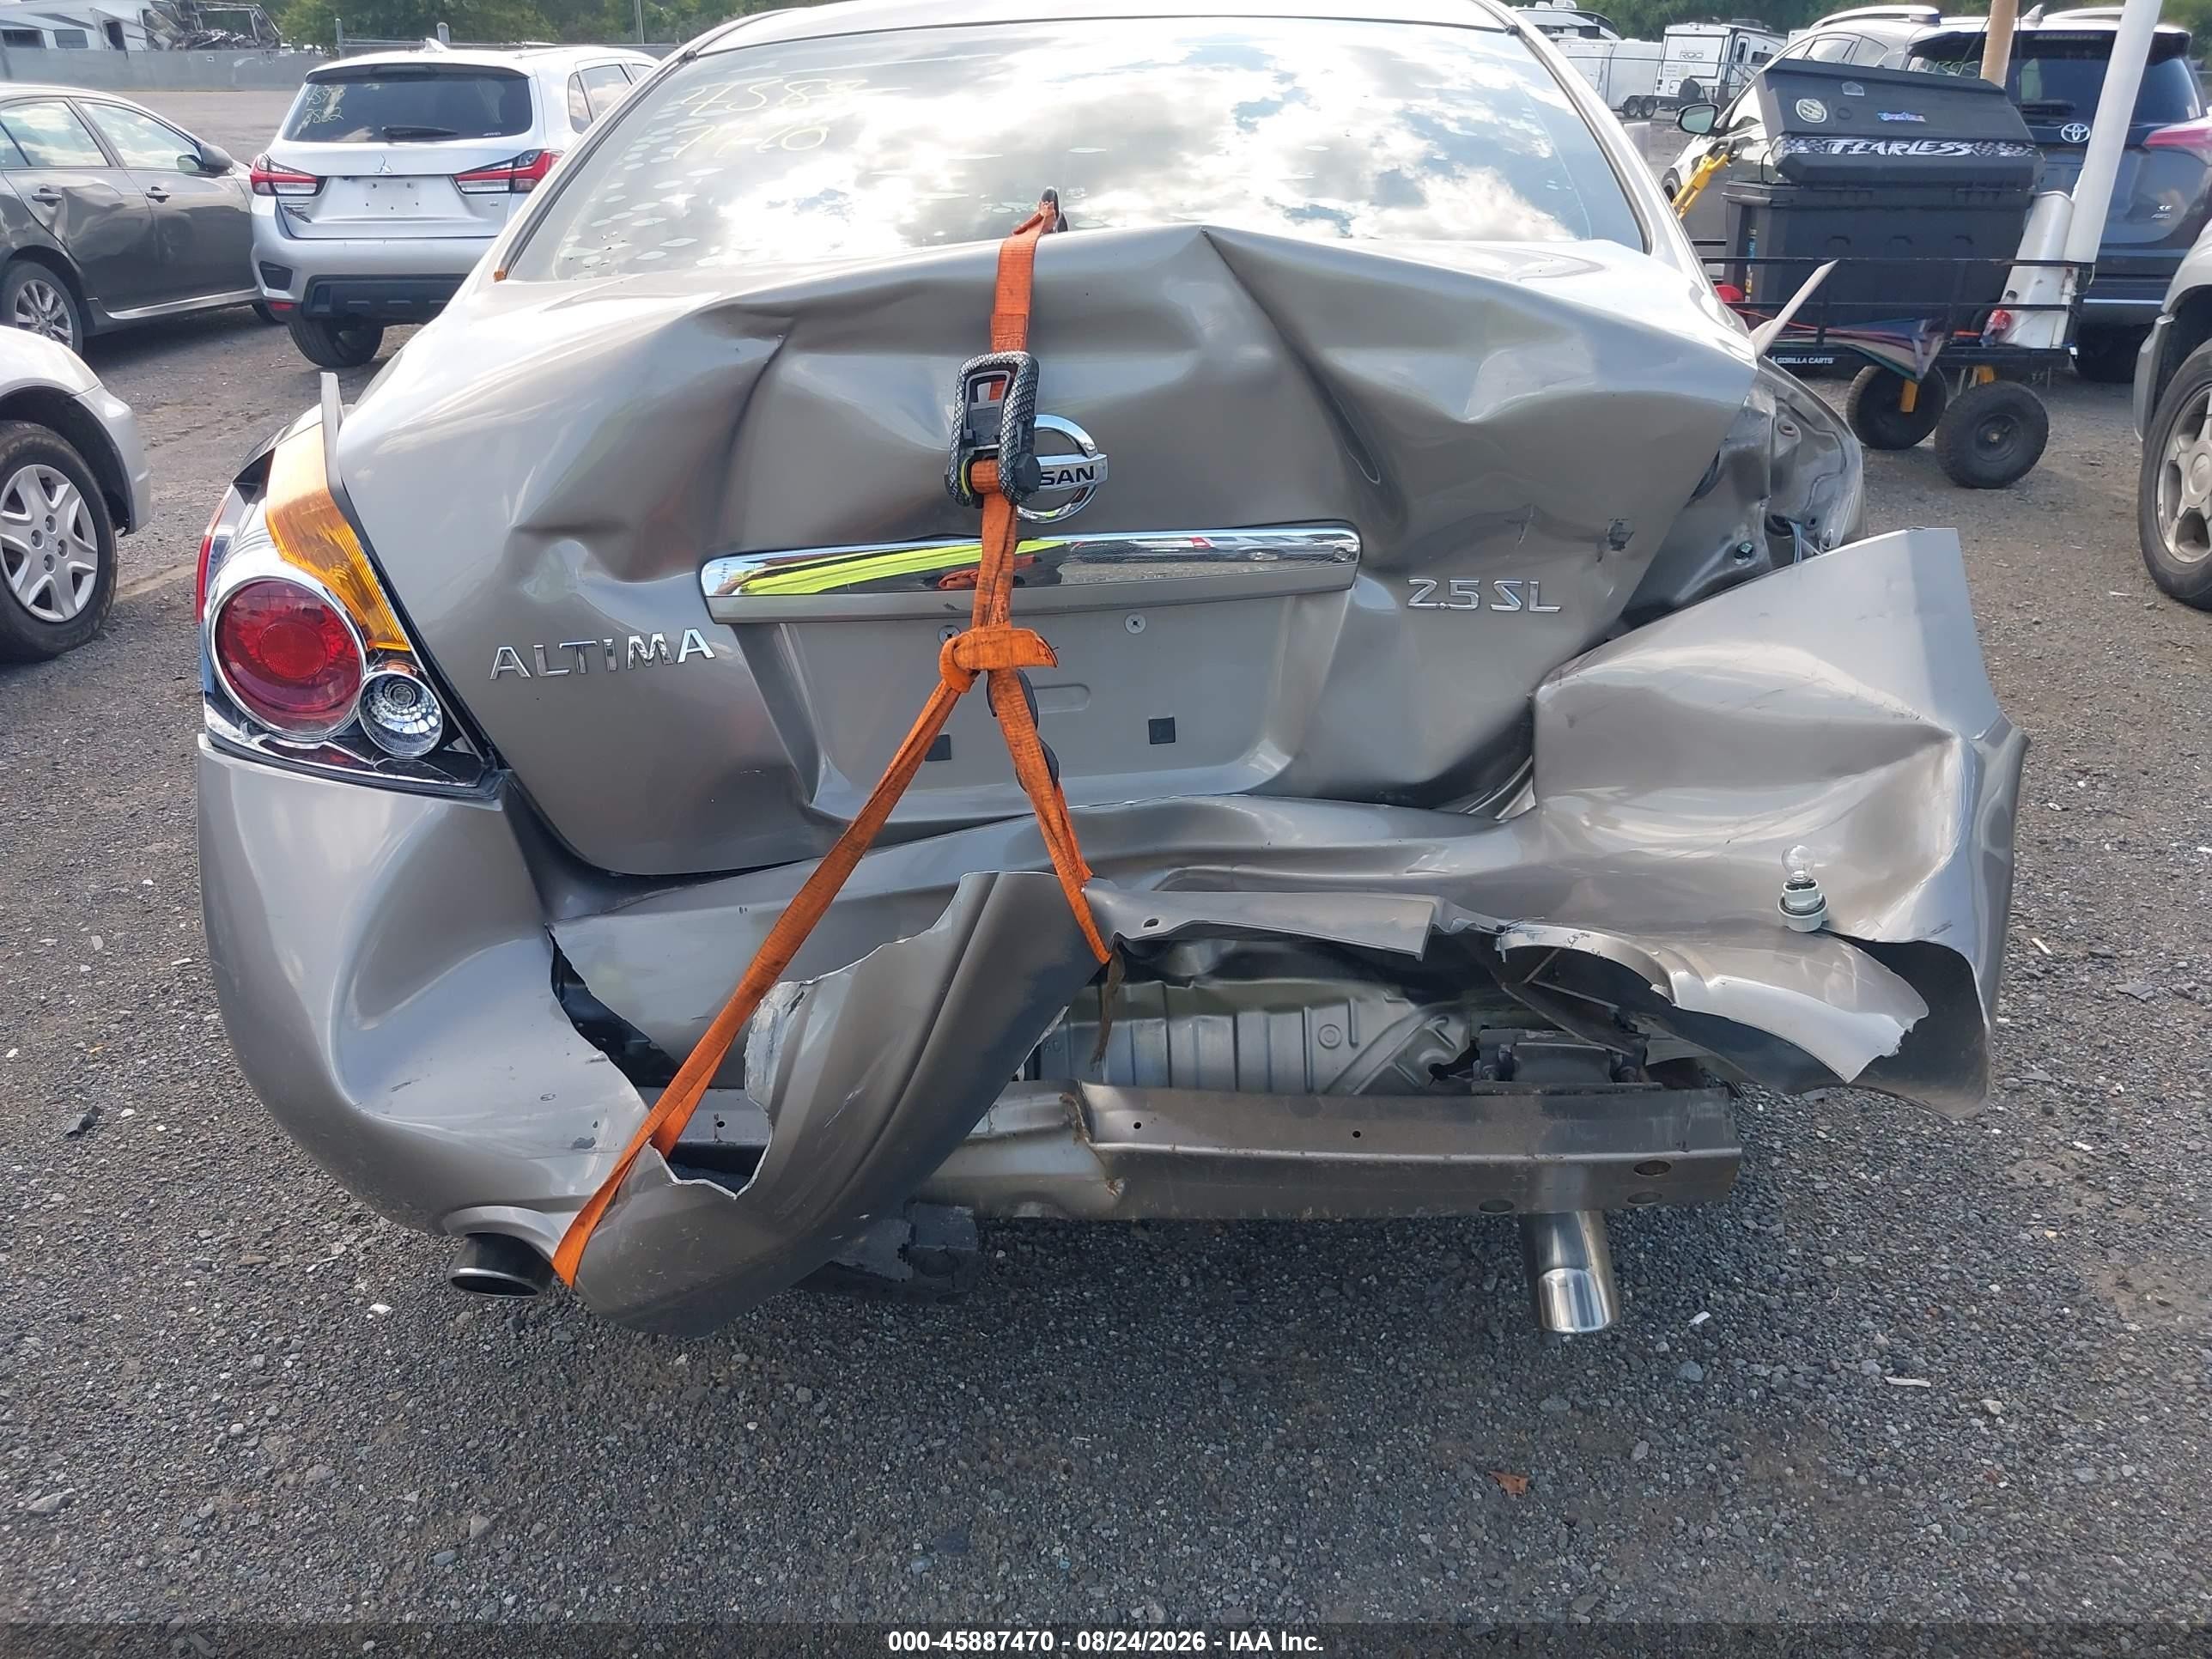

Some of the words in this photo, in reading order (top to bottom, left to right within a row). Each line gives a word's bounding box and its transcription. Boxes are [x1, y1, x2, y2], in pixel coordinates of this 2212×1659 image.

[1407, 578, 1480, 611] 2.5
[1490, 580, 1561, 612] SL
[489, 627, 716, 681] ALTIMA
